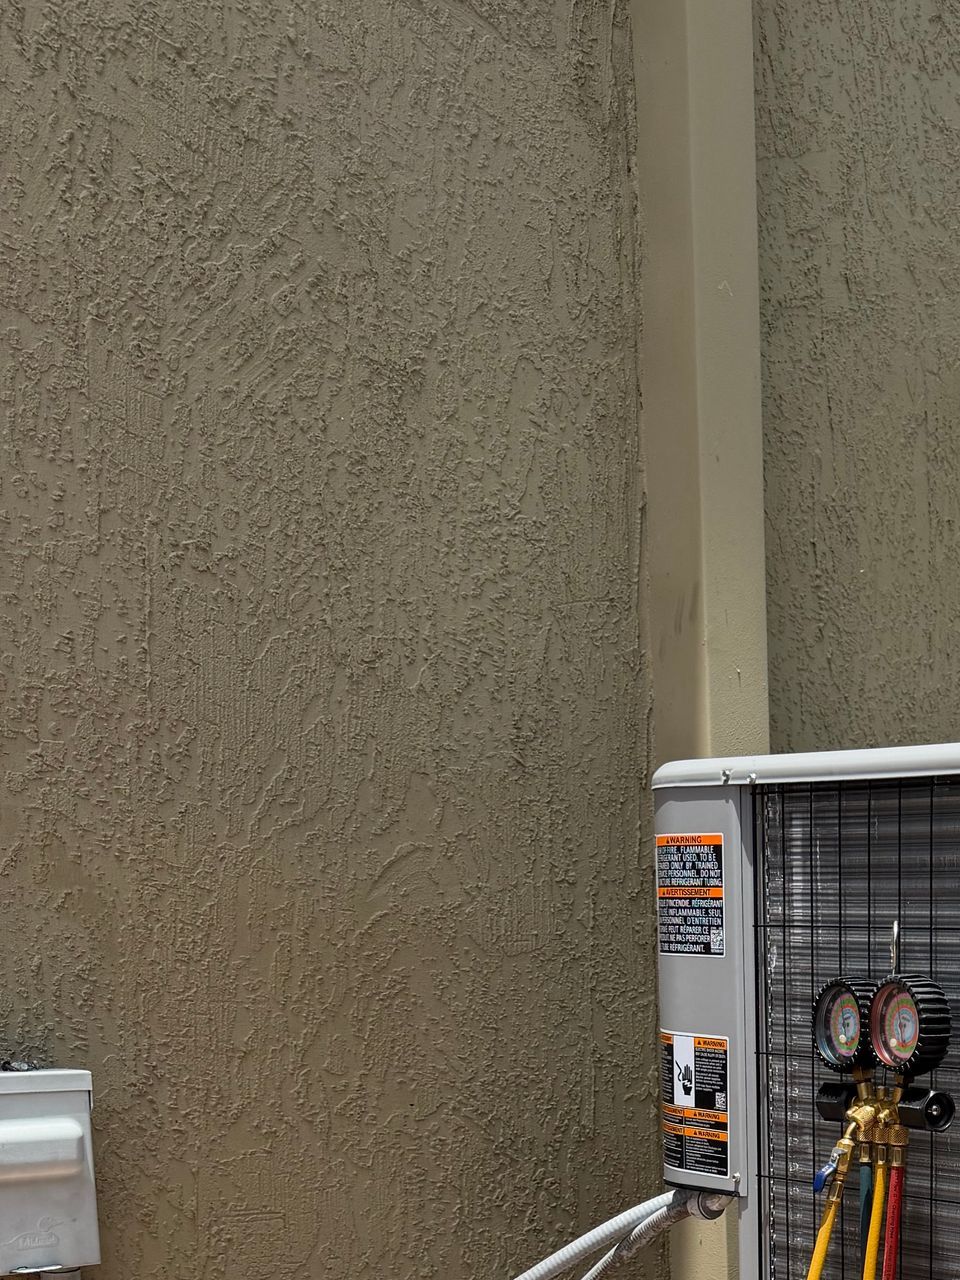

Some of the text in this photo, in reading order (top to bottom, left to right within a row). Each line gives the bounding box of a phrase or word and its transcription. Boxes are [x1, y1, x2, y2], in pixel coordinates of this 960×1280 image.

[670, 836, 702, 844] WARNING
[672, 878, 703, 886] REFRIGERANT
[692, 898, 722, 907] RÉFRIGÉRANT
[708, 909, 722, 917] SEUL
[687, 917, 721, 925] D'ENTRETIEN
[703, 1040, 725, 1048] WARNING
[698, 1112, 720, 1120] WARNING
[698, 1131, 720, 1139] WARNING
